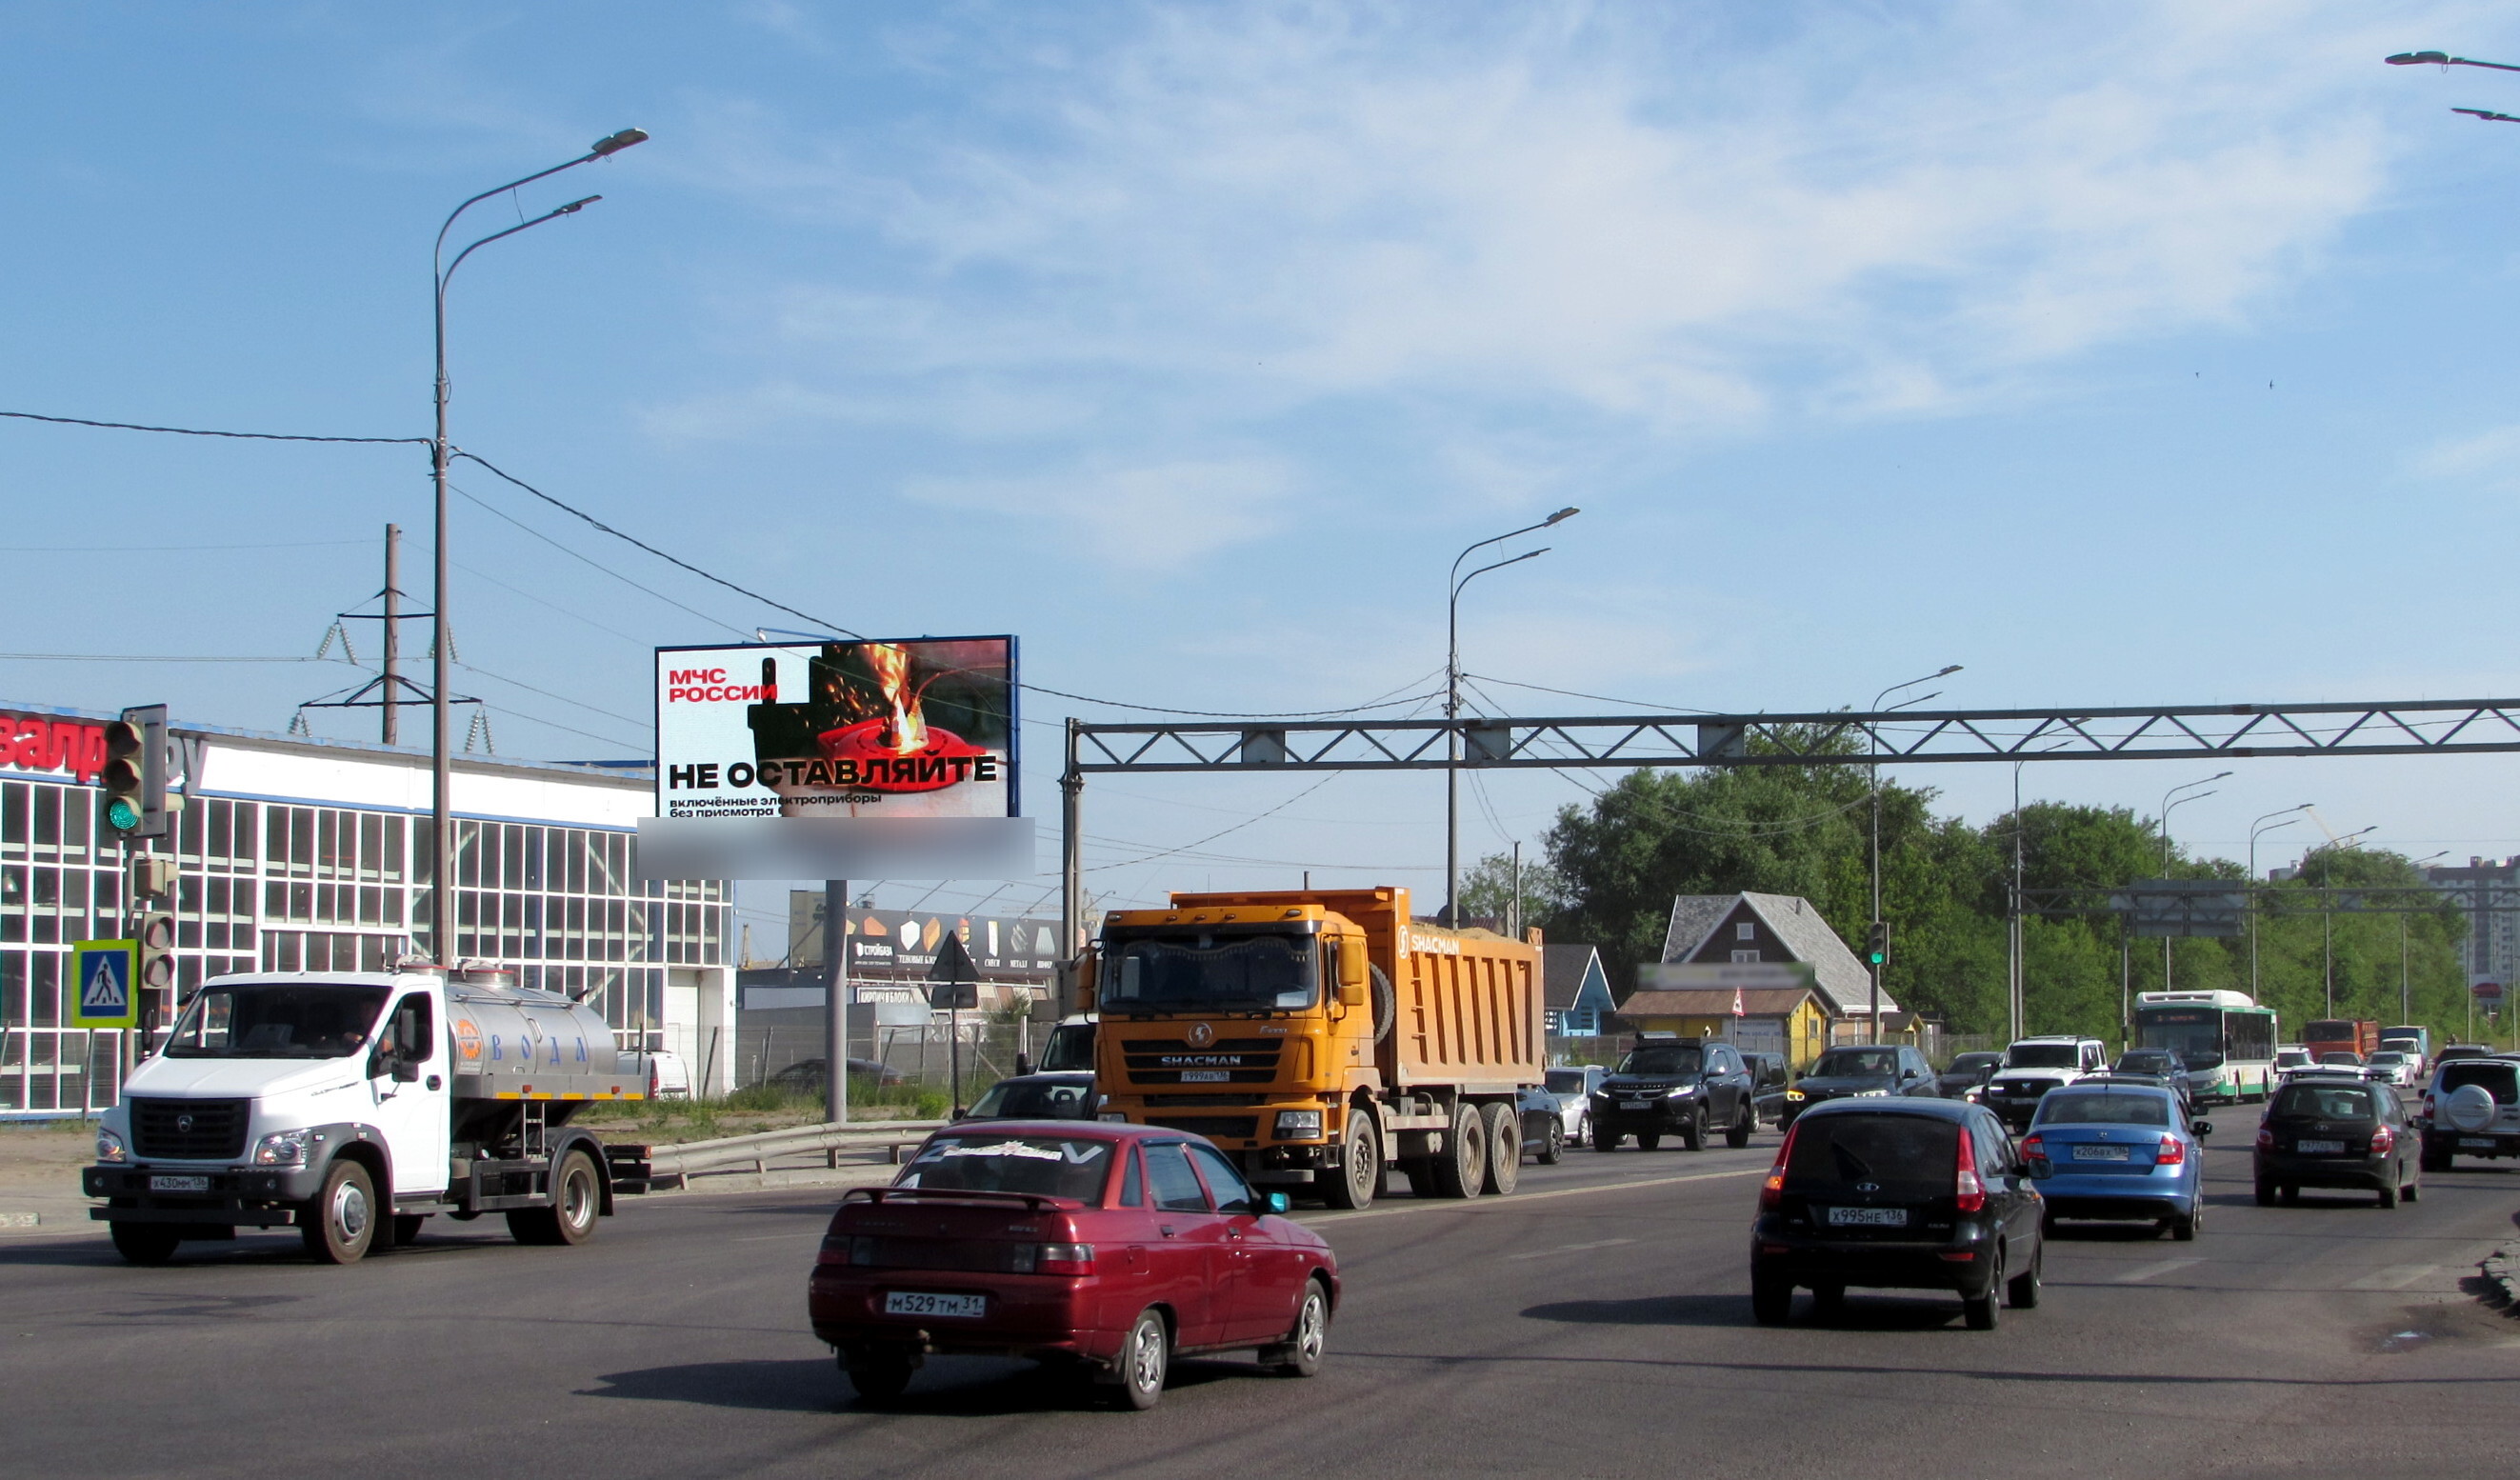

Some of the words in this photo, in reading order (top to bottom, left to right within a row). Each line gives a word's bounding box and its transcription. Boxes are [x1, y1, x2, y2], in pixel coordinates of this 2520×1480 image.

[670, 669, 727, 685] МЧС
[670, 684, 777, 703] РОССИИ
[670, 764, 718, 790] НЕ
[727, 750, 997, 789] ОСТАВЛЯЙТЕ
[670, 796, 758, 808] включённые
[760, 794, 881, 807] электроприборы
[670, 808, 693, 818] без
[696, 807, 773, 818] присмотра
[1411, 934, 1460, 955] SHACMAN
[897, 955, 924, 965] ТЕНОВЫЕ
[491, 1034, 587, 1067] ВОДА
[1161, 1055, 1241, 1067] SHACMAN
[962, 1296, 979, 1310] 31
